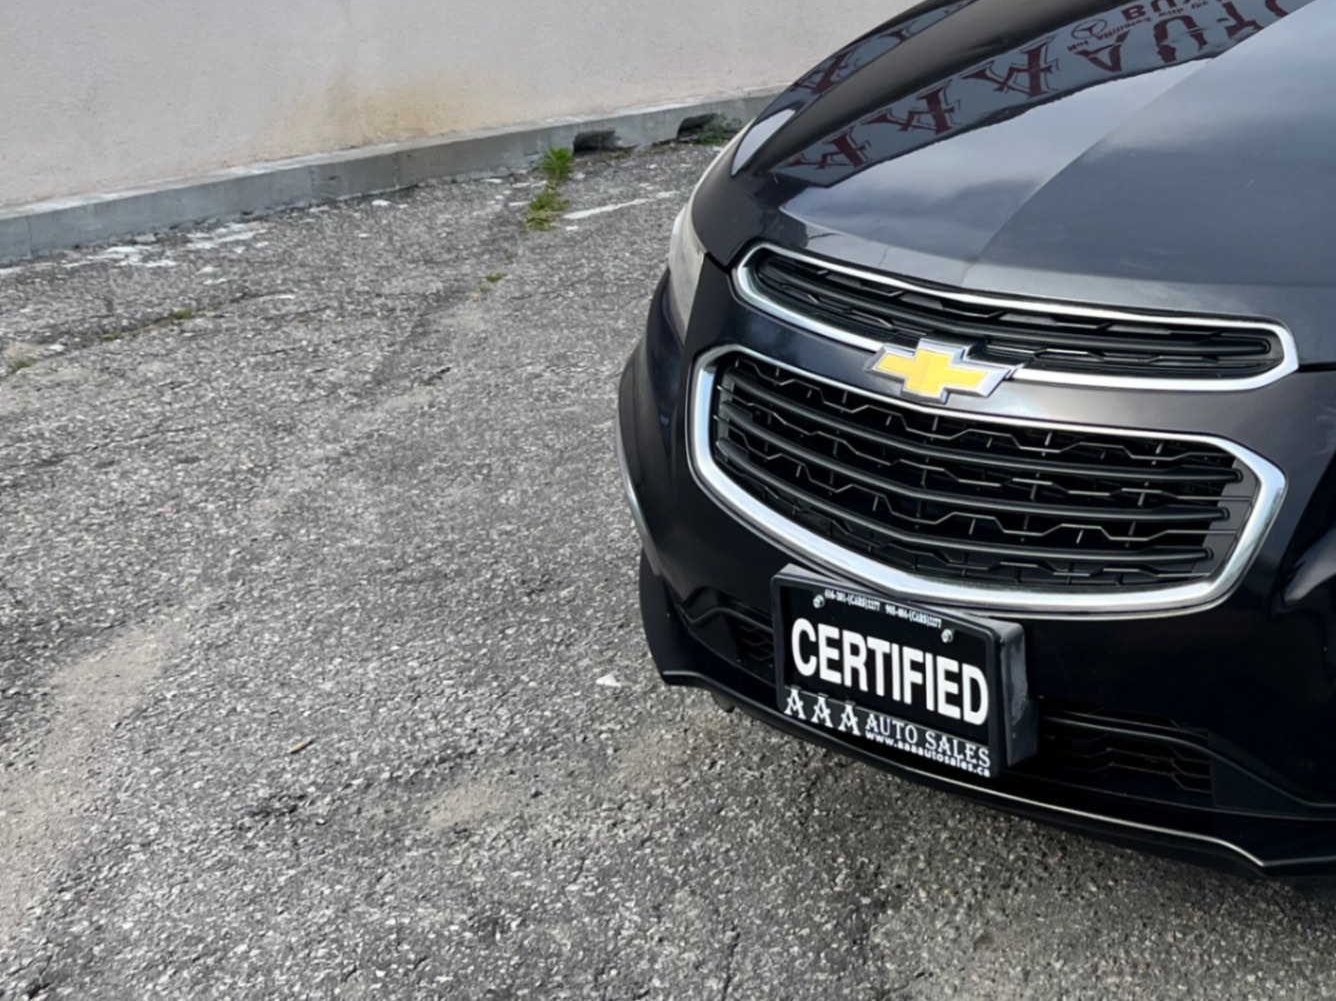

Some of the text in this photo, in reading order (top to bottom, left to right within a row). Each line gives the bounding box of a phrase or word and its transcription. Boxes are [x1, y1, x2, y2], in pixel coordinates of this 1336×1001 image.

[791, 618, 989, 726] CERTIFIED
[865, 713, 917, 744] AUTO
[925, 730, 991, 768] SALES
